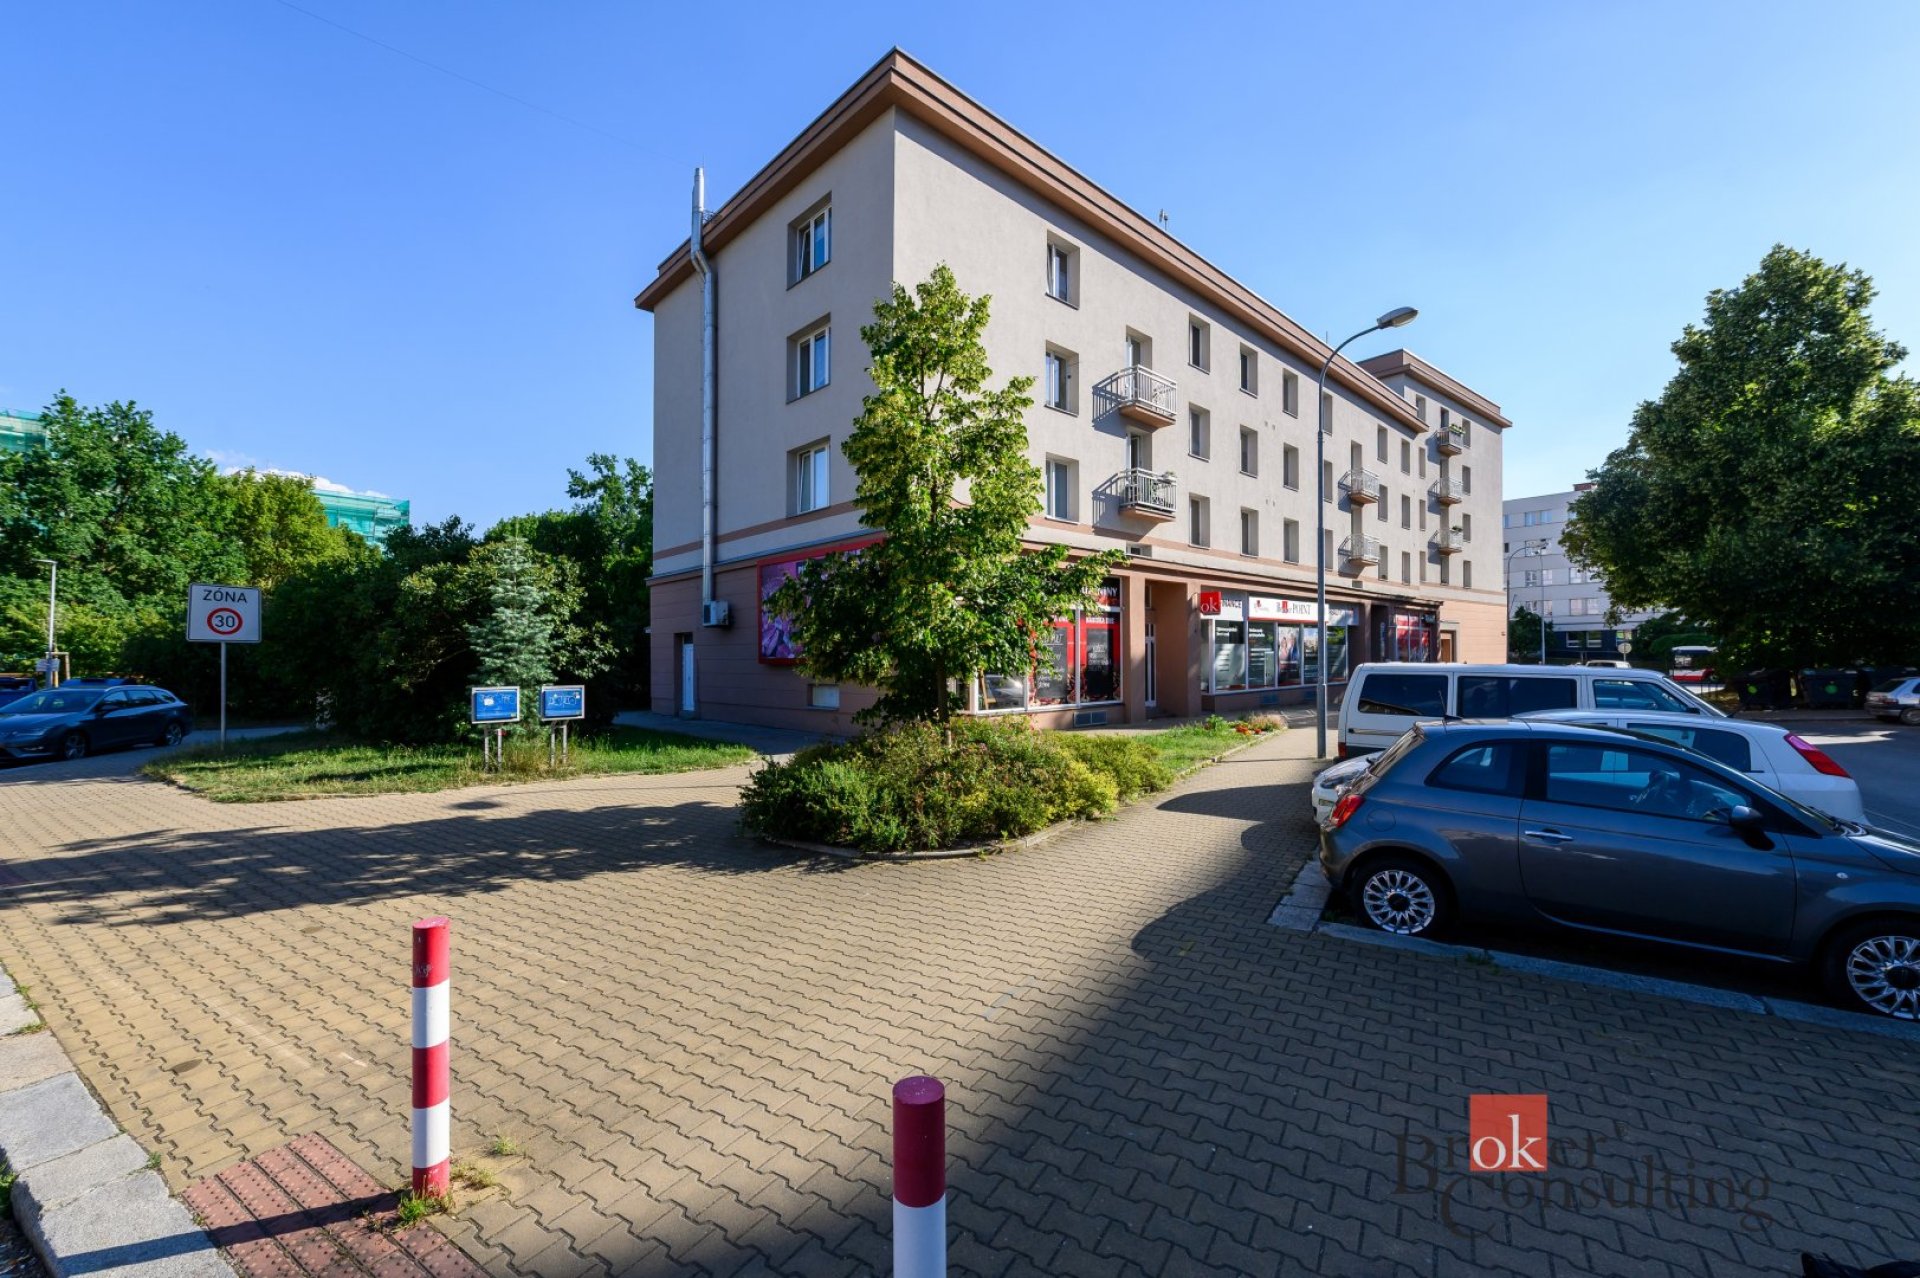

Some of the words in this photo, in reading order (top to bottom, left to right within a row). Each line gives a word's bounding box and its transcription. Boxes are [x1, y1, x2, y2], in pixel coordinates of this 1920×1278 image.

[203, 588, 248, 603] ZÓNA
[1201, 597, 1219, 612] ok
[214, 614, 235, 628] 30
